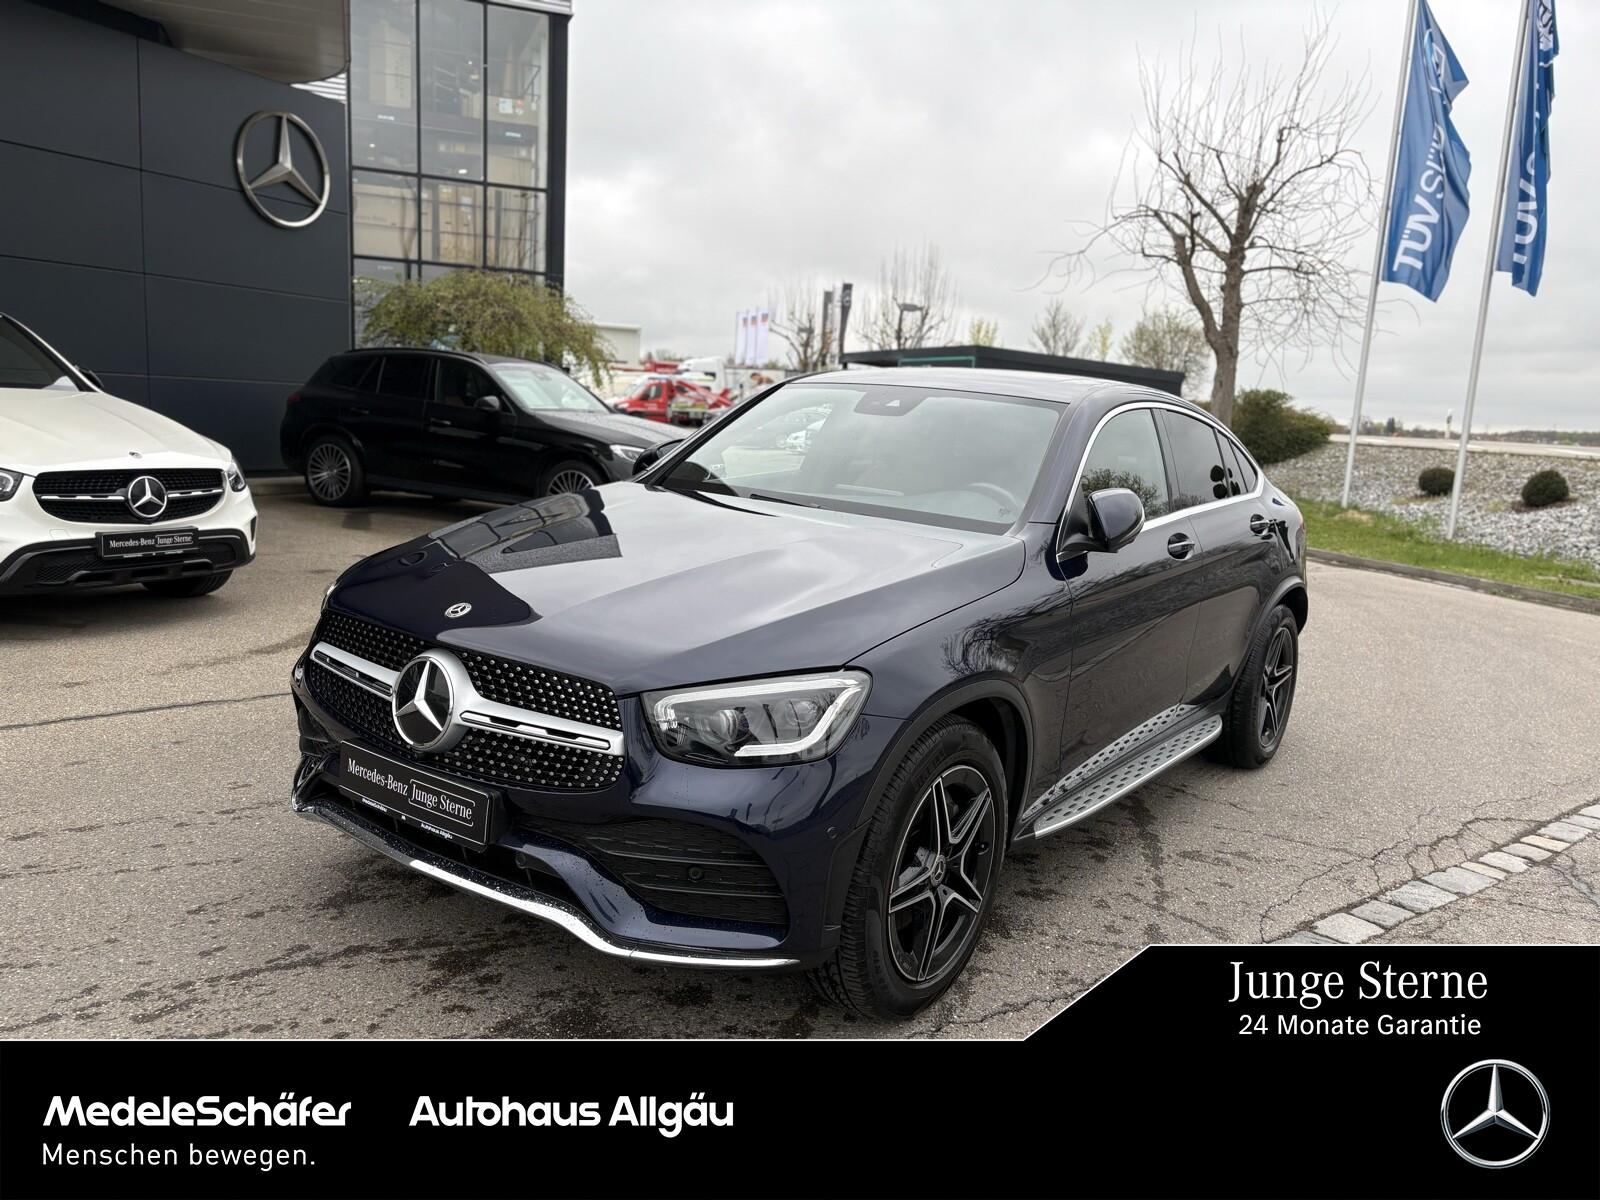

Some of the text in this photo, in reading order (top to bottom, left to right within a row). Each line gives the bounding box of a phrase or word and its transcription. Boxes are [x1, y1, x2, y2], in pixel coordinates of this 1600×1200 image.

[1392, 194, 1440, 271] TÜV
[109, 535, 192, 548] Mercedes-Benz Junge Sterne
[347, 758, 408, 796] Mercedes-Benz
[411, 784, 438, 808] Junge
[439, 794, 472, 820] Sterne
